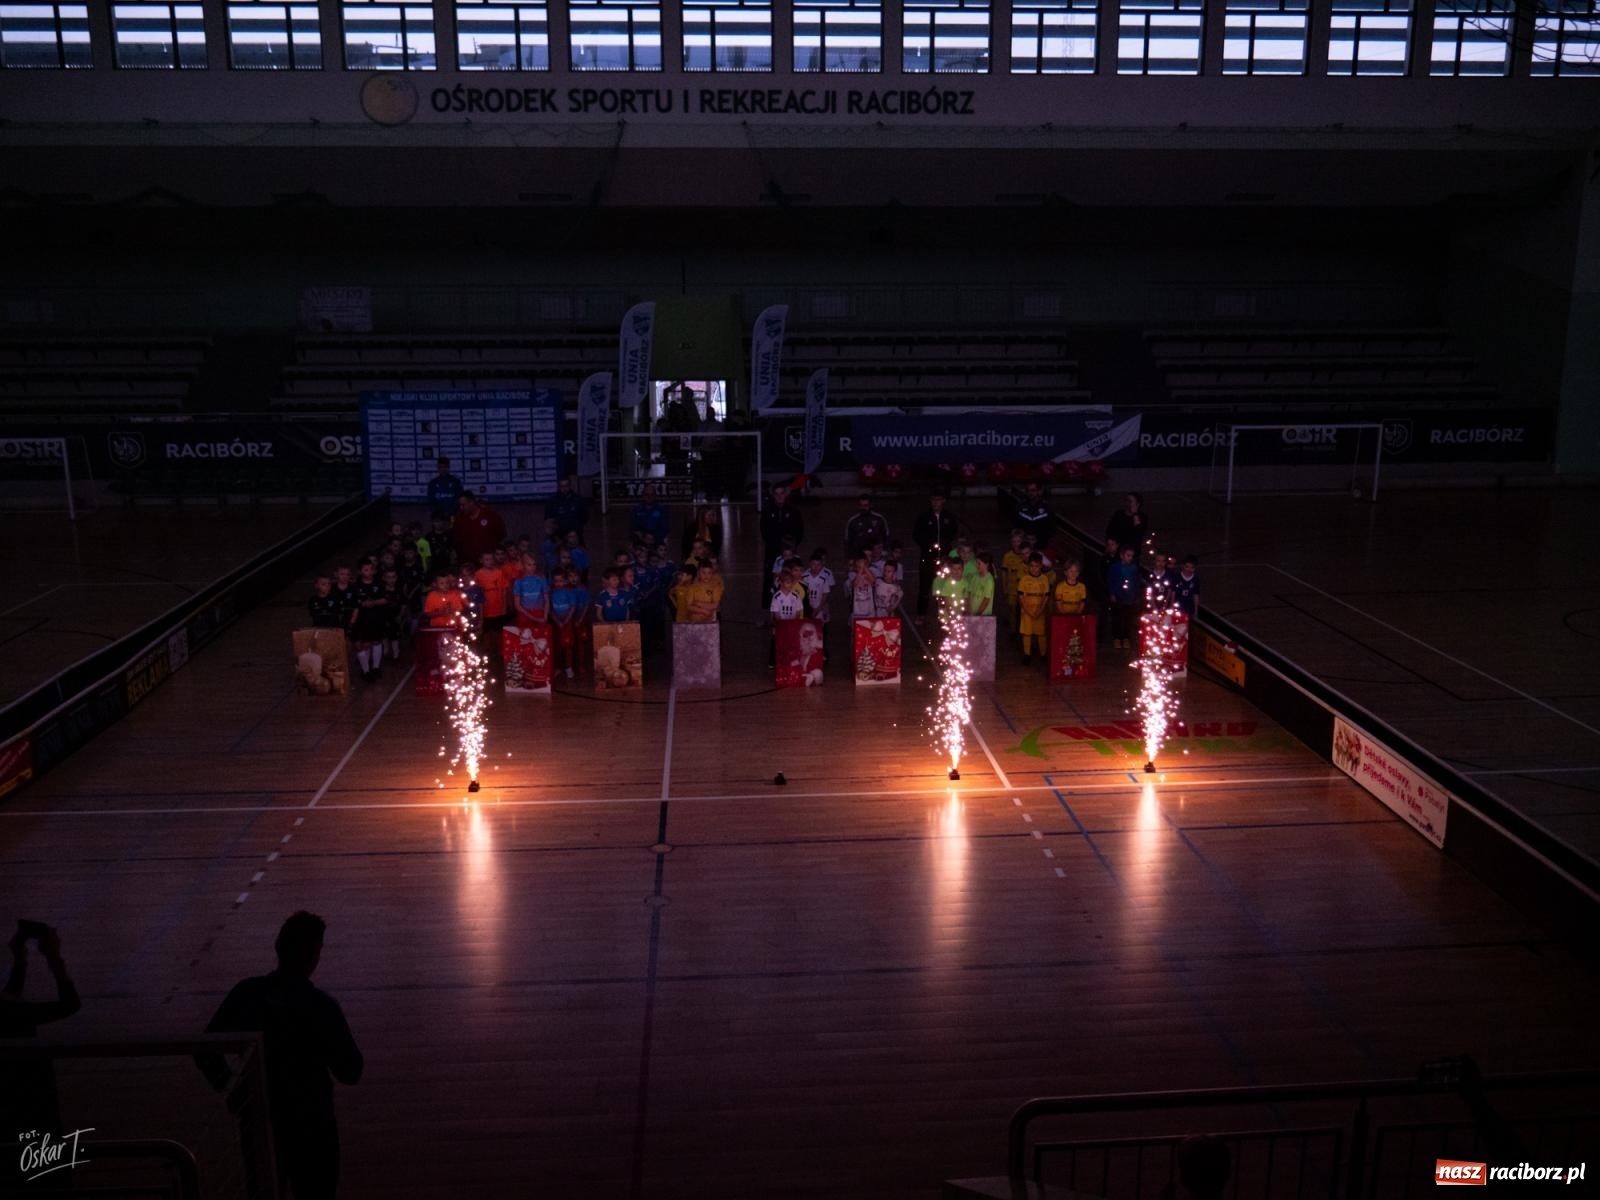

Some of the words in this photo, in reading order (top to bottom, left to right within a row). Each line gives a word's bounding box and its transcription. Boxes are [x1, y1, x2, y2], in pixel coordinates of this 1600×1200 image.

[431, 83, 558, 113] OŚRODEK
[568, 88, 672, 114] SPORTU
[683, 88, 689, 113] I
[700, 88, 837, 114] REKREACJI
[847, 86, 975, 115] RACIBÓRZ
[628, 349, 640, 384] UNIA
[760, 352, 771, 386] UNIA
[165, 437, 274, 459] RACIBÓRZ
[586, 418, 597, 452] UNIA
[872, 429, 1055, 448] www.uniaraciborz.eu
[1139, 427, 1239, 448] RACIBÓRZ
[1429, 425, 1525, 444] RACIBÓRZ
